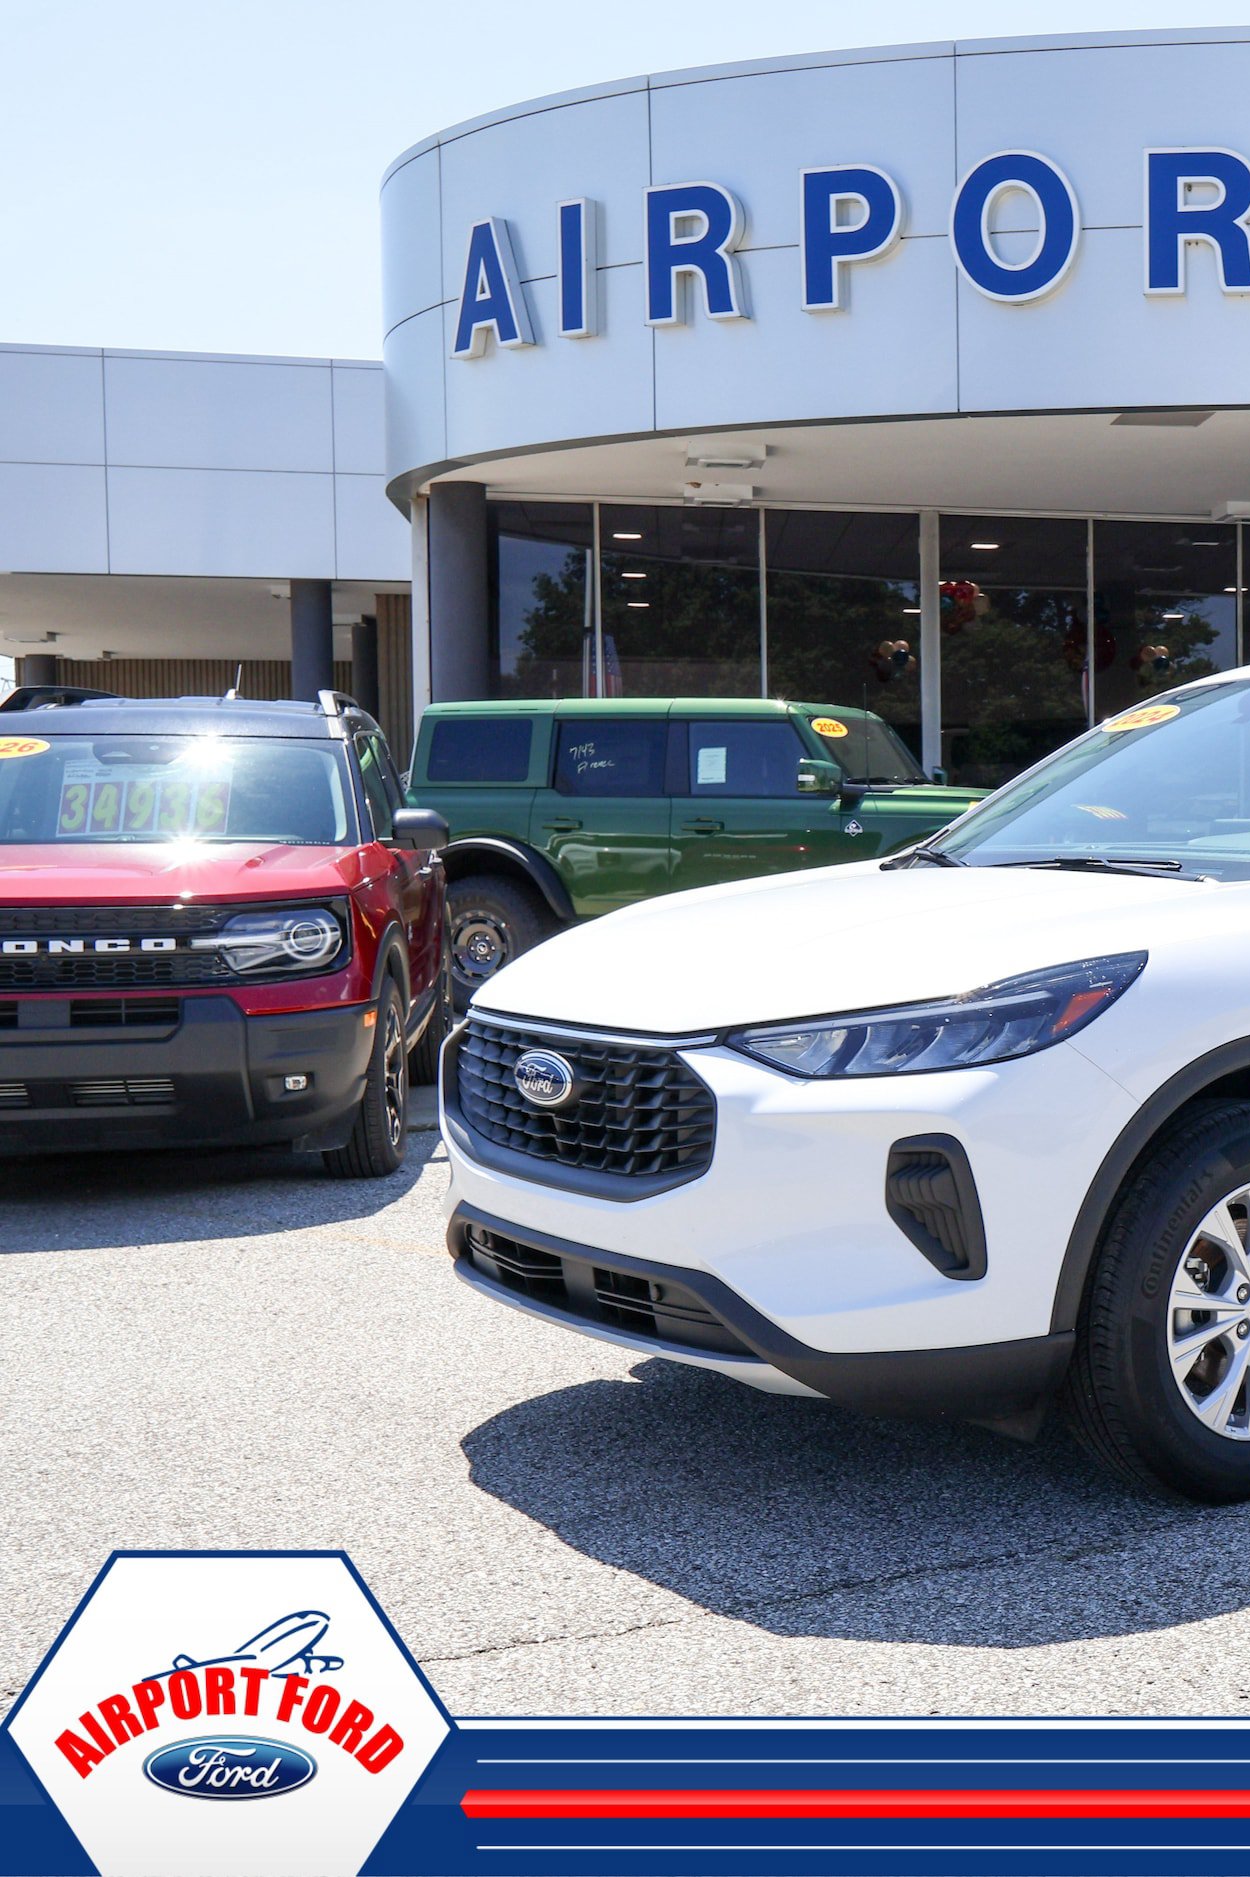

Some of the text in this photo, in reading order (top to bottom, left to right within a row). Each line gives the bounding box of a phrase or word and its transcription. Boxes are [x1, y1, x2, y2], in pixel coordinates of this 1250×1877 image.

[816, 722, 844, 733] 2025
[60, 783, 225, 830] 34936
[2, 938, 177, 953] ONCO
[522, 1062, 553, 1094] Ford
[1141, 1178, 1204, 1300] Continental
